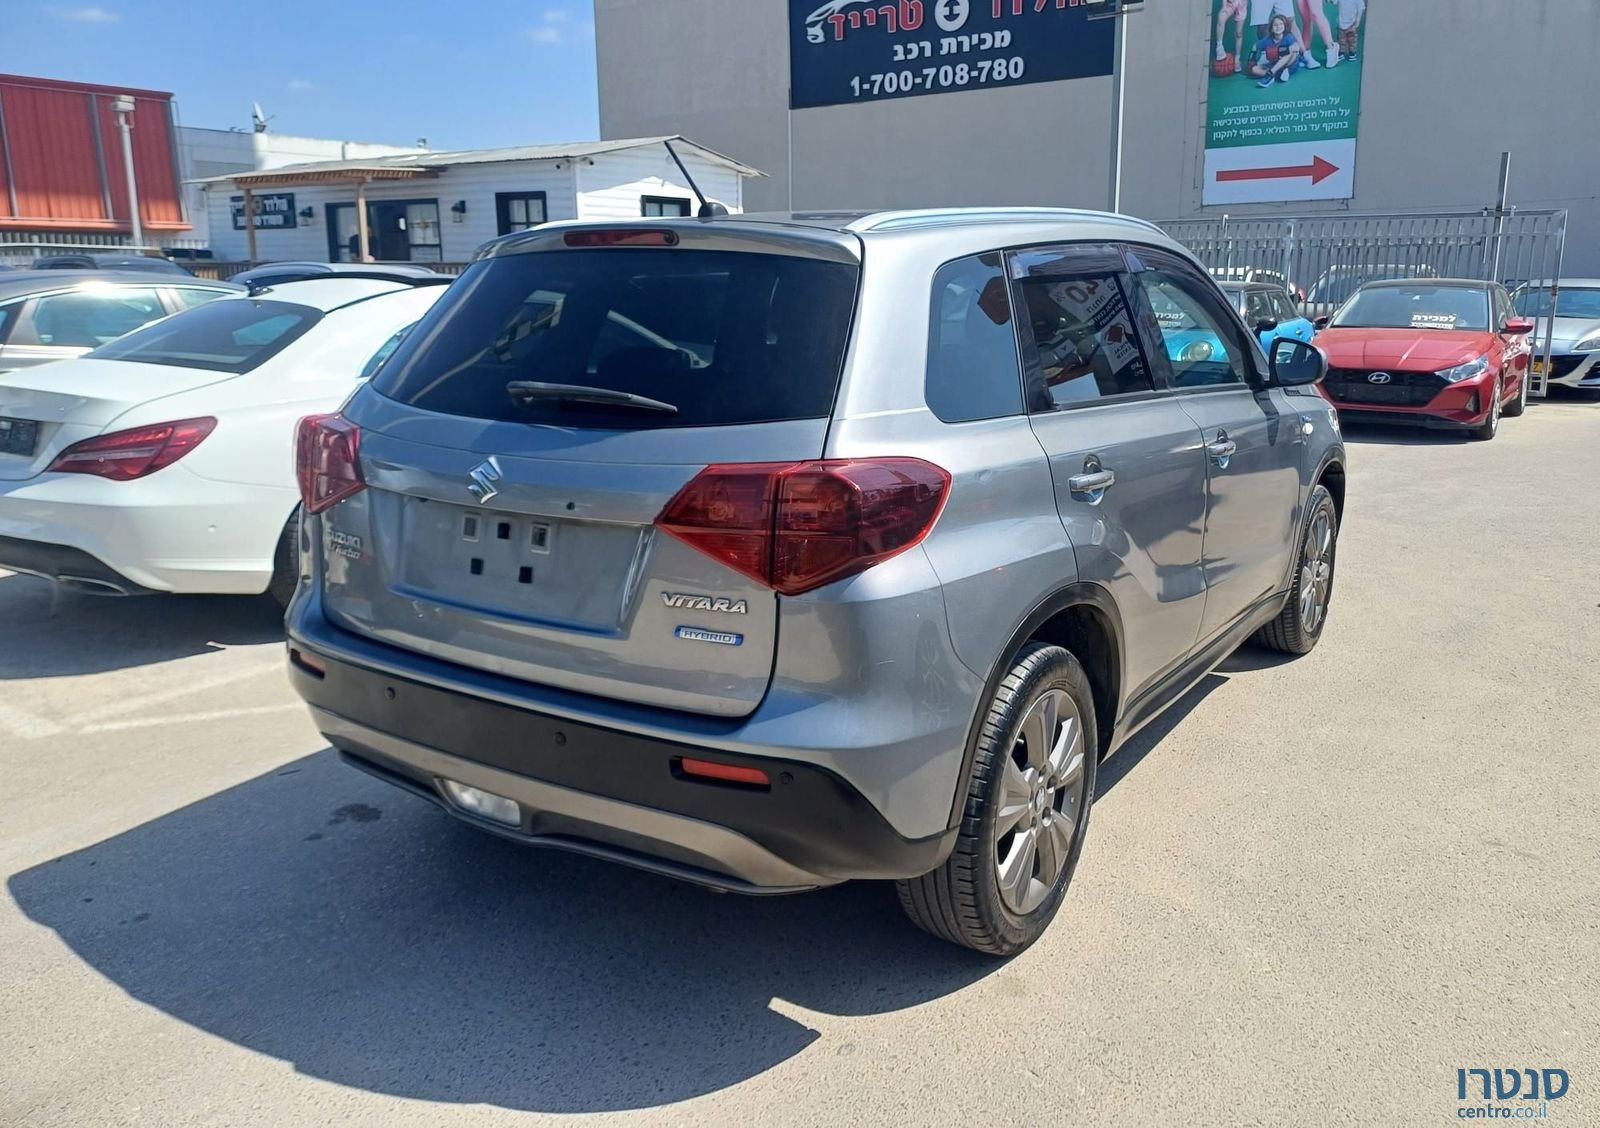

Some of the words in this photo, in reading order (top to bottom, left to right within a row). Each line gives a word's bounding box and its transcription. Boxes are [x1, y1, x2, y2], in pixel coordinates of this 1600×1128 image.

[827, 0, 924, 40] טרייד
[939, 29, 1012, 56] מכירת
[892, 41, 932, 61] רכב
[850, 57, 1024, 96] 1-700-708-780
[1329, 96, 1340, 105] על
[1223, 105, 1249, 115] במבצע
[1251, 101, 1295, 111] המשתתפים
[1283, 112, 1299, 121] כלל
[1300, 111, 1317, 122] מבין
[1320, 109, 1337, 117] הזול
[1339, 108, 1350, 116] על
[1213, 117, 1249, 127] שברכישה
[1250, 114, 1282, 123] המוצרים
[1293, 124, 1307, 132] גמר
[1310, 123, 1320, 132] עד
[1322, 121, 1349, 132] בתוקף
[1240, 128, 1262, 139] בכפוף
[1412, 313, 1457, 322] למכירה
[661, 592, 748, 614] VITARA
[683, 630, 732, 643] HYBRID
